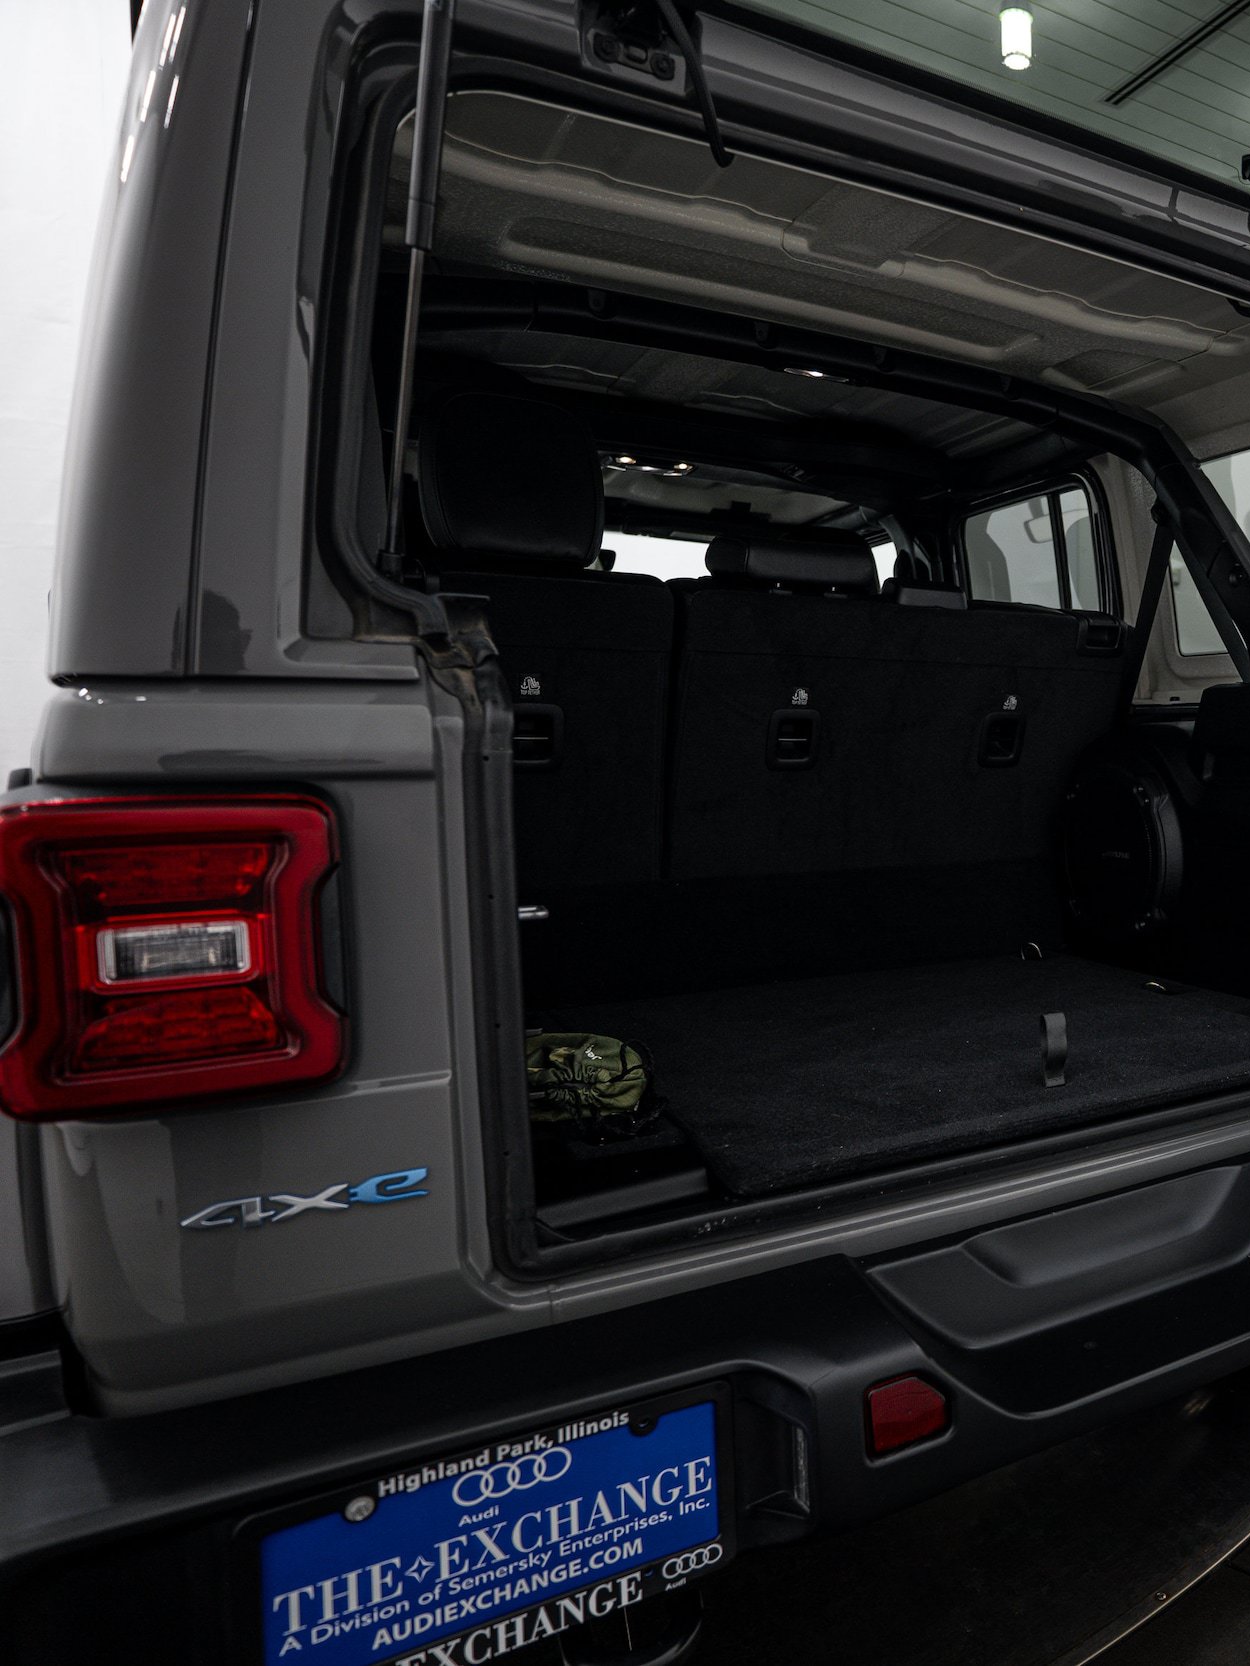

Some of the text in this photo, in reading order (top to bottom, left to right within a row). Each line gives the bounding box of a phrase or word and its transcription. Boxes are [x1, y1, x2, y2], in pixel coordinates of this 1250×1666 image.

[377, 1410, 630, 1498] Highland Park, Illinois
[272, 1455, 713, 1637] THE EXCHANGE
[458, 1505, 500, 1527] Audi
[278, 1497, 711, 1658] A Division of Semersky Enterprises, Inc.
[371, 1536, 644, 1651] AUDIEXCHANGE.COM
